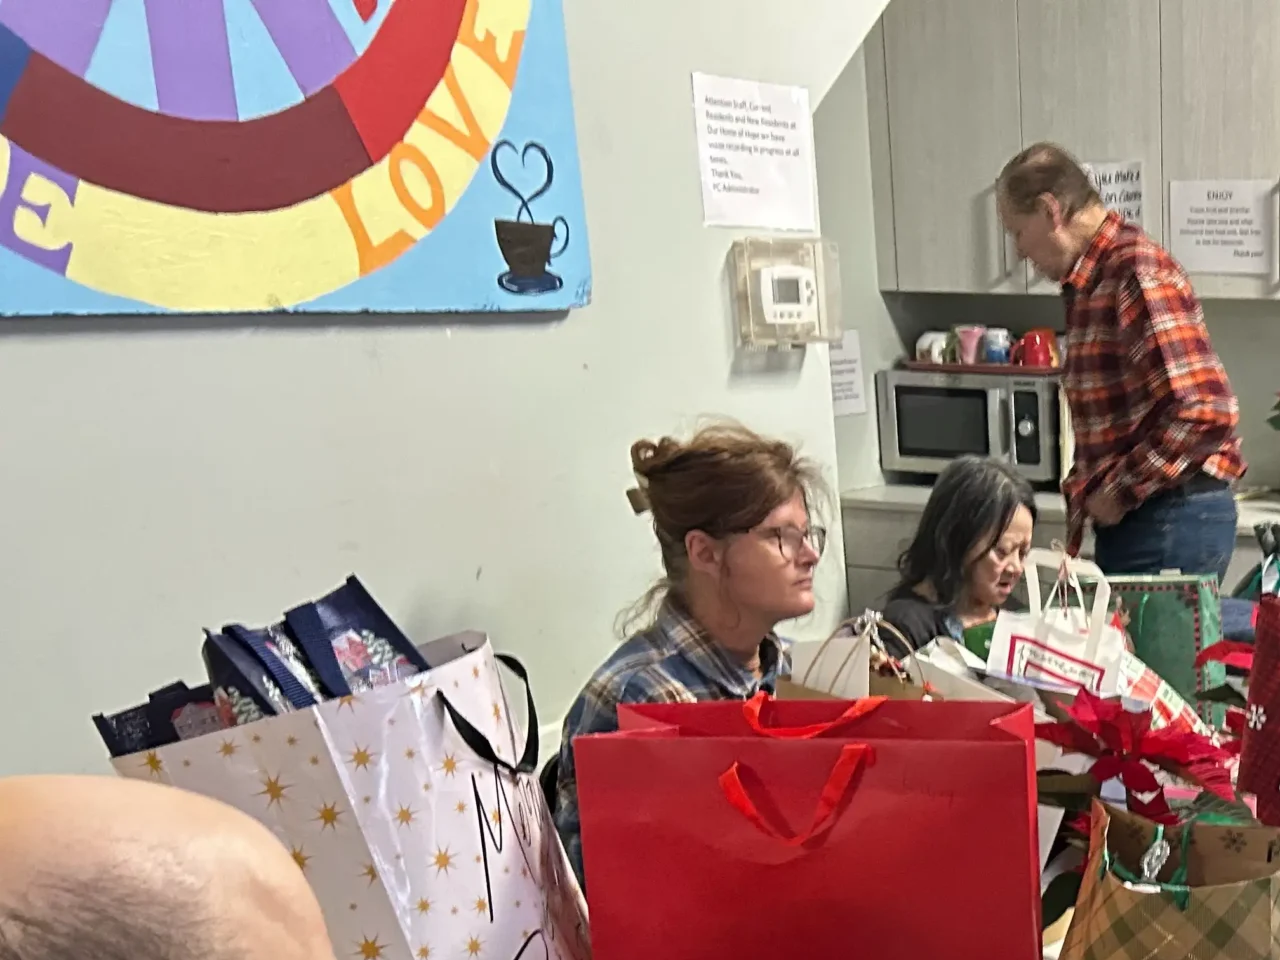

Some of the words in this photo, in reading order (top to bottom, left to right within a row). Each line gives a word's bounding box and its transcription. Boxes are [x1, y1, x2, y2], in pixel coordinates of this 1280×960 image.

[735, 115, 746, 123] and
[707, 124, 718, 135] Our
[719, 127, 737, 137] Home
[328, 0, 527, 277] LOVE
[726, 143, 753, 155] recording
[760, 147, 784, 156] progress
[1206, 190, 1233, 201] ENJOY
